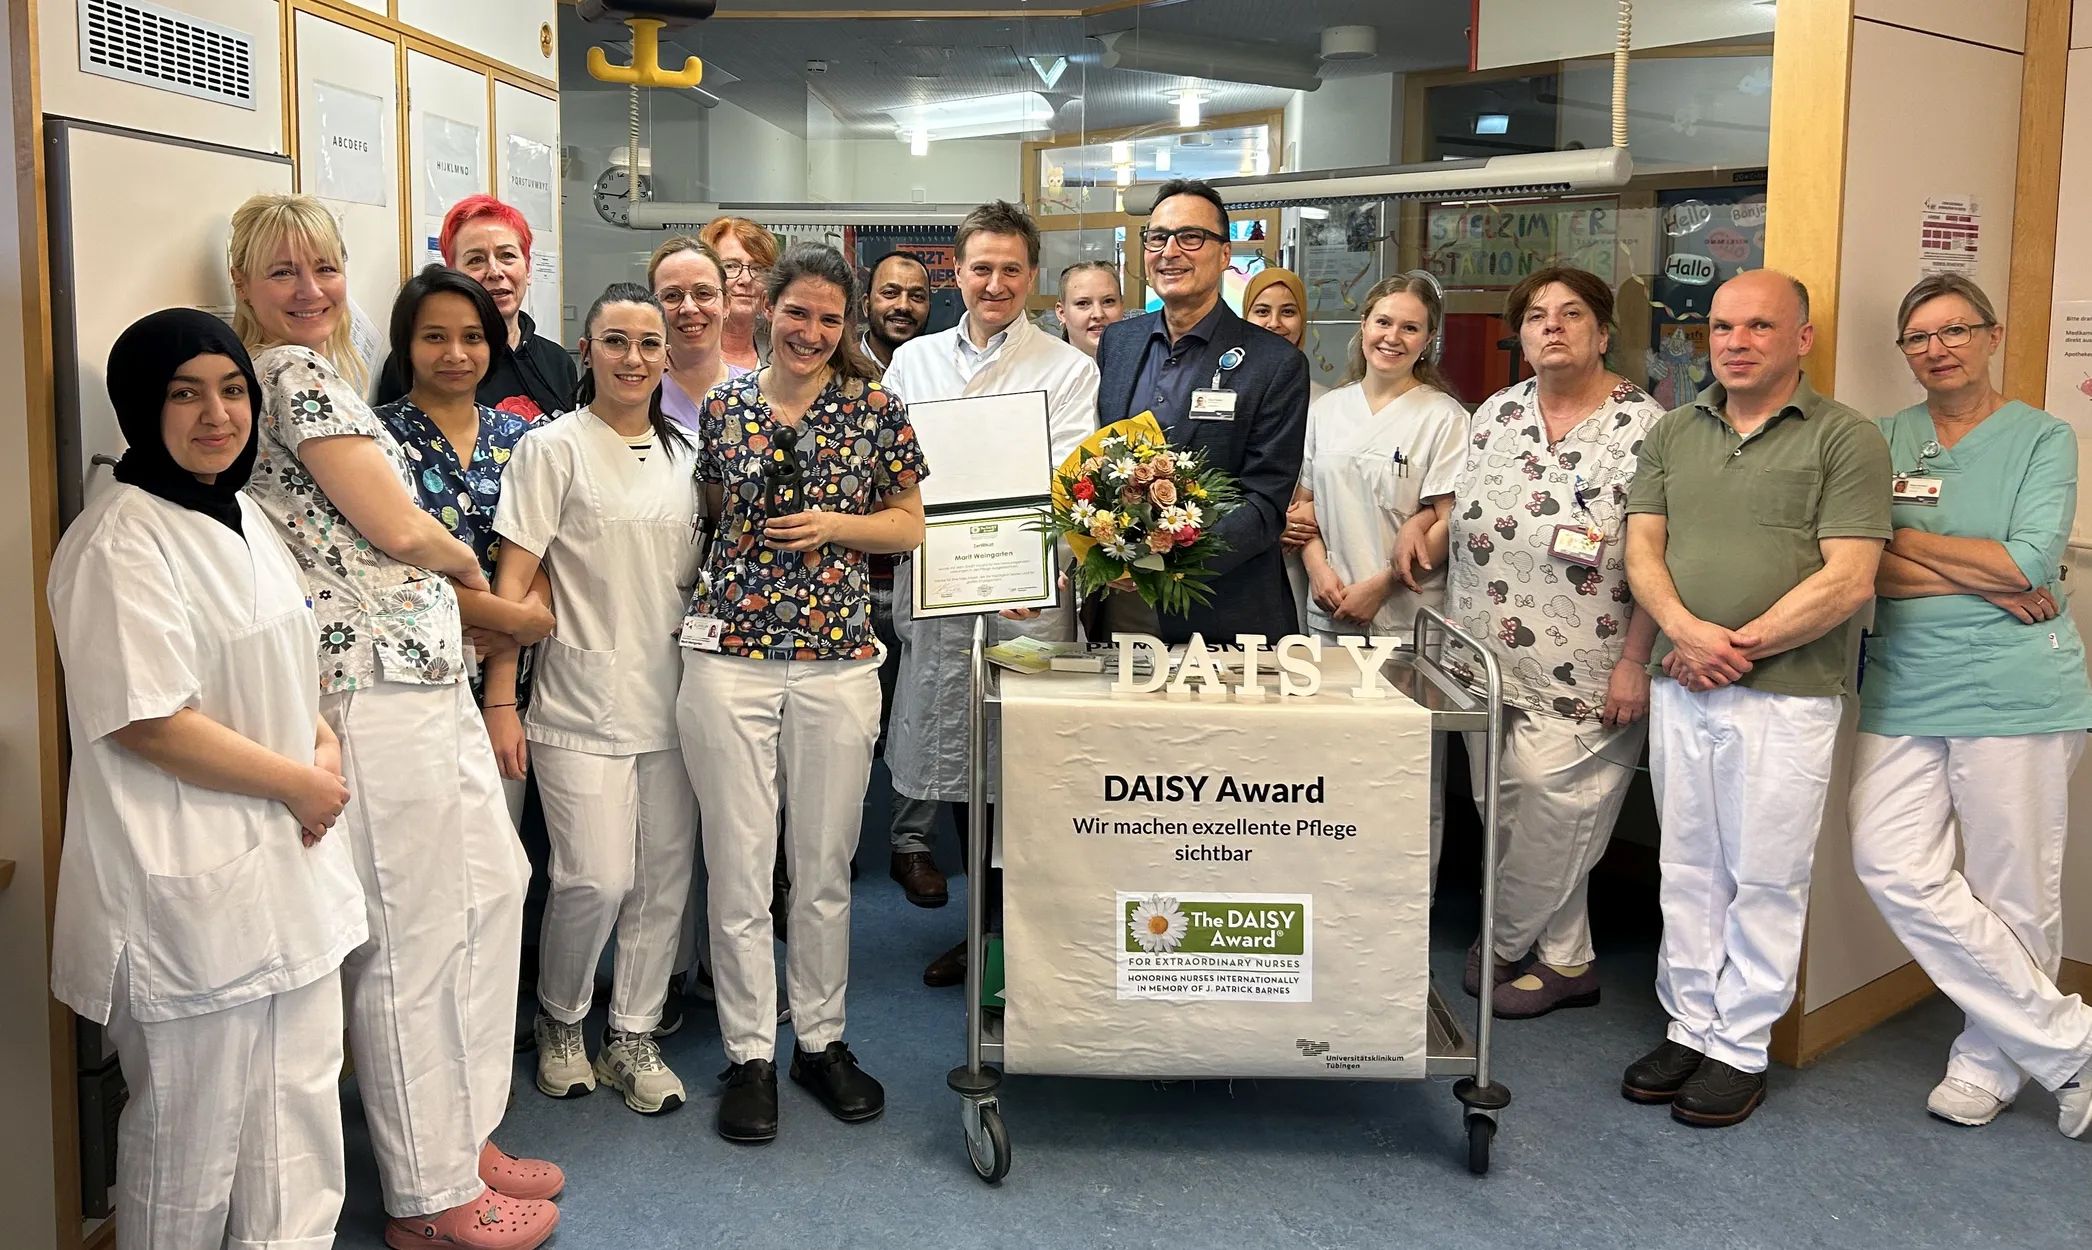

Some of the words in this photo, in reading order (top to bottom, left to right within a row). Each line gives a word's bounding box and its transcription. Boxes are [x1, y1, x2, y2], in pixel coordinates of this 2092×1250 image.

[332, 135, 368, 152] ABCDEFG
[436, 160, 469, 176] HIJKLMNO
[1664, 205, 1709, 233] Hello
[913, 251, 949, 264] RZT-
[1666, 257, 1711, 277] Hallo
[954, 553, 972, 561] Marit
[974, 550, 1014, 560] Weingarten
[1111, 632, 1401, 698] DAISY
[1104, 775, 1208, 802] DAISY
[1215, 776, 1324, 804] Award
[1072, 817, 1109, 834] Wir
[1114, 818, 1187, 835] machen
[1192, 818, 1291, 836] exzellente
[1296, 819, 1357, 840] Pflege
[1175, 844, 1252, 861] sichtbar
[1191, 911, 1224, 928] The
[1227, 909, 1296, 929] DAISY
[1128, 957, 1151, 966] FOR
[1155, 957, 1251, 968] EXTRAORDINARY
[1255, 959, 1300, 969] NURSES
[1128, 974, 1178, 983] HONORING
[1180, 975, 1214, 983] NURSES
[1217, 975, 1300, 985] INTERNATIONALLY
[1137, 984, 1147, 992] IN
[1149, 985, 1189, 993] MEMORY
[1191, 985, 1203, 993] OF
[1205, 985, 1213, 993] J.
[1215, 985, 1252, 994] PATRICK
[1255, 986, 1290, 995] BARNES
[1326, 1054, 1404, 1062] Universitätsklinikum
[1326, 1062, 1360, 1070] Tübingen
